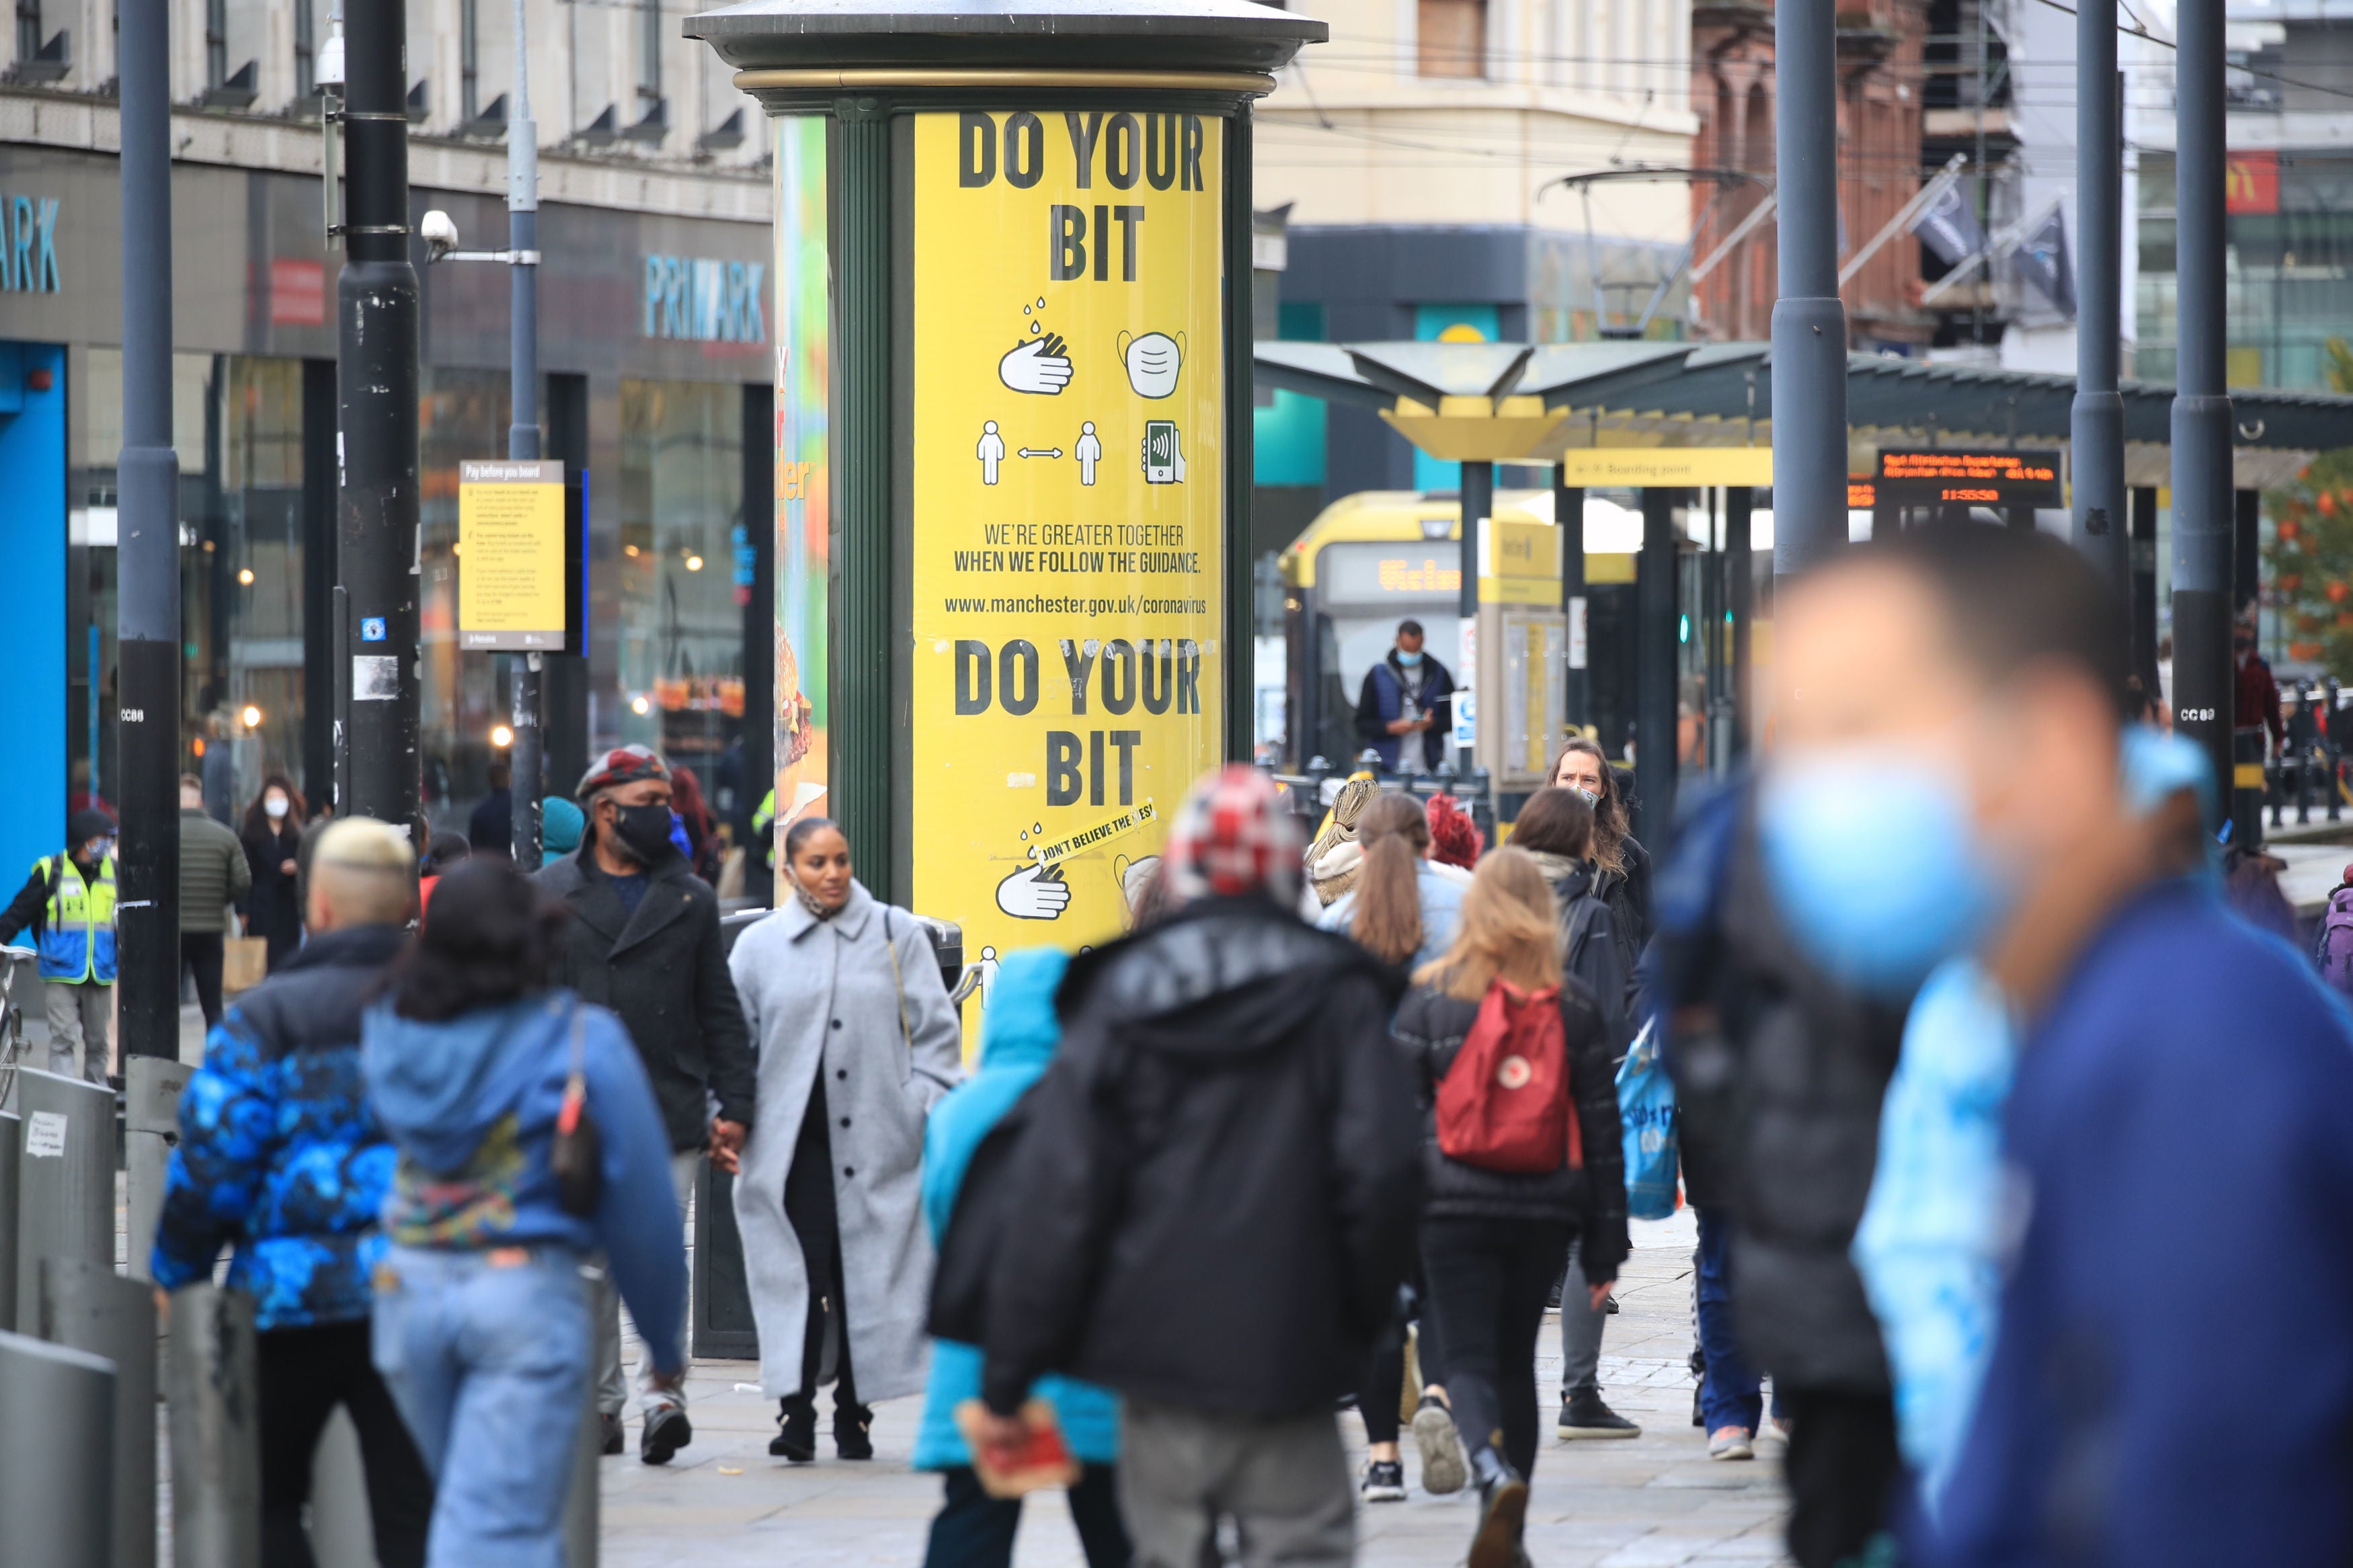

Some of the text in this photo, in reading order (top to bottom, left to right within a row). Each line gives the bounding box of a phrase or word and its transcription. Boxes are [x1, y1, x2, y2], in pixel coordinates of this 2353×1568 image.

[959, 112, 1204, 192] DO YOUR
[1050, 204, 1145, 282] BIT
[645, 254, 766, 344] PRIMARK
[465, 464, 540, 481] Pay before you board
[954, 551, 1201, 573] WHEN WE FOLLOW THE GUIDANCE.
[985, 524, 1183, 546] WE'RE GREATER TOGETHER
[945, 594, 1206, 617] www.manchester.gov.uk/coronavirus
[955, 638, 1201, 716] DO YOUR
[1047, 731, 1141, 806] BIT
[1072, 823, 1111, 849] BELIEVE
[1112, 815, 1131, 832] THE
